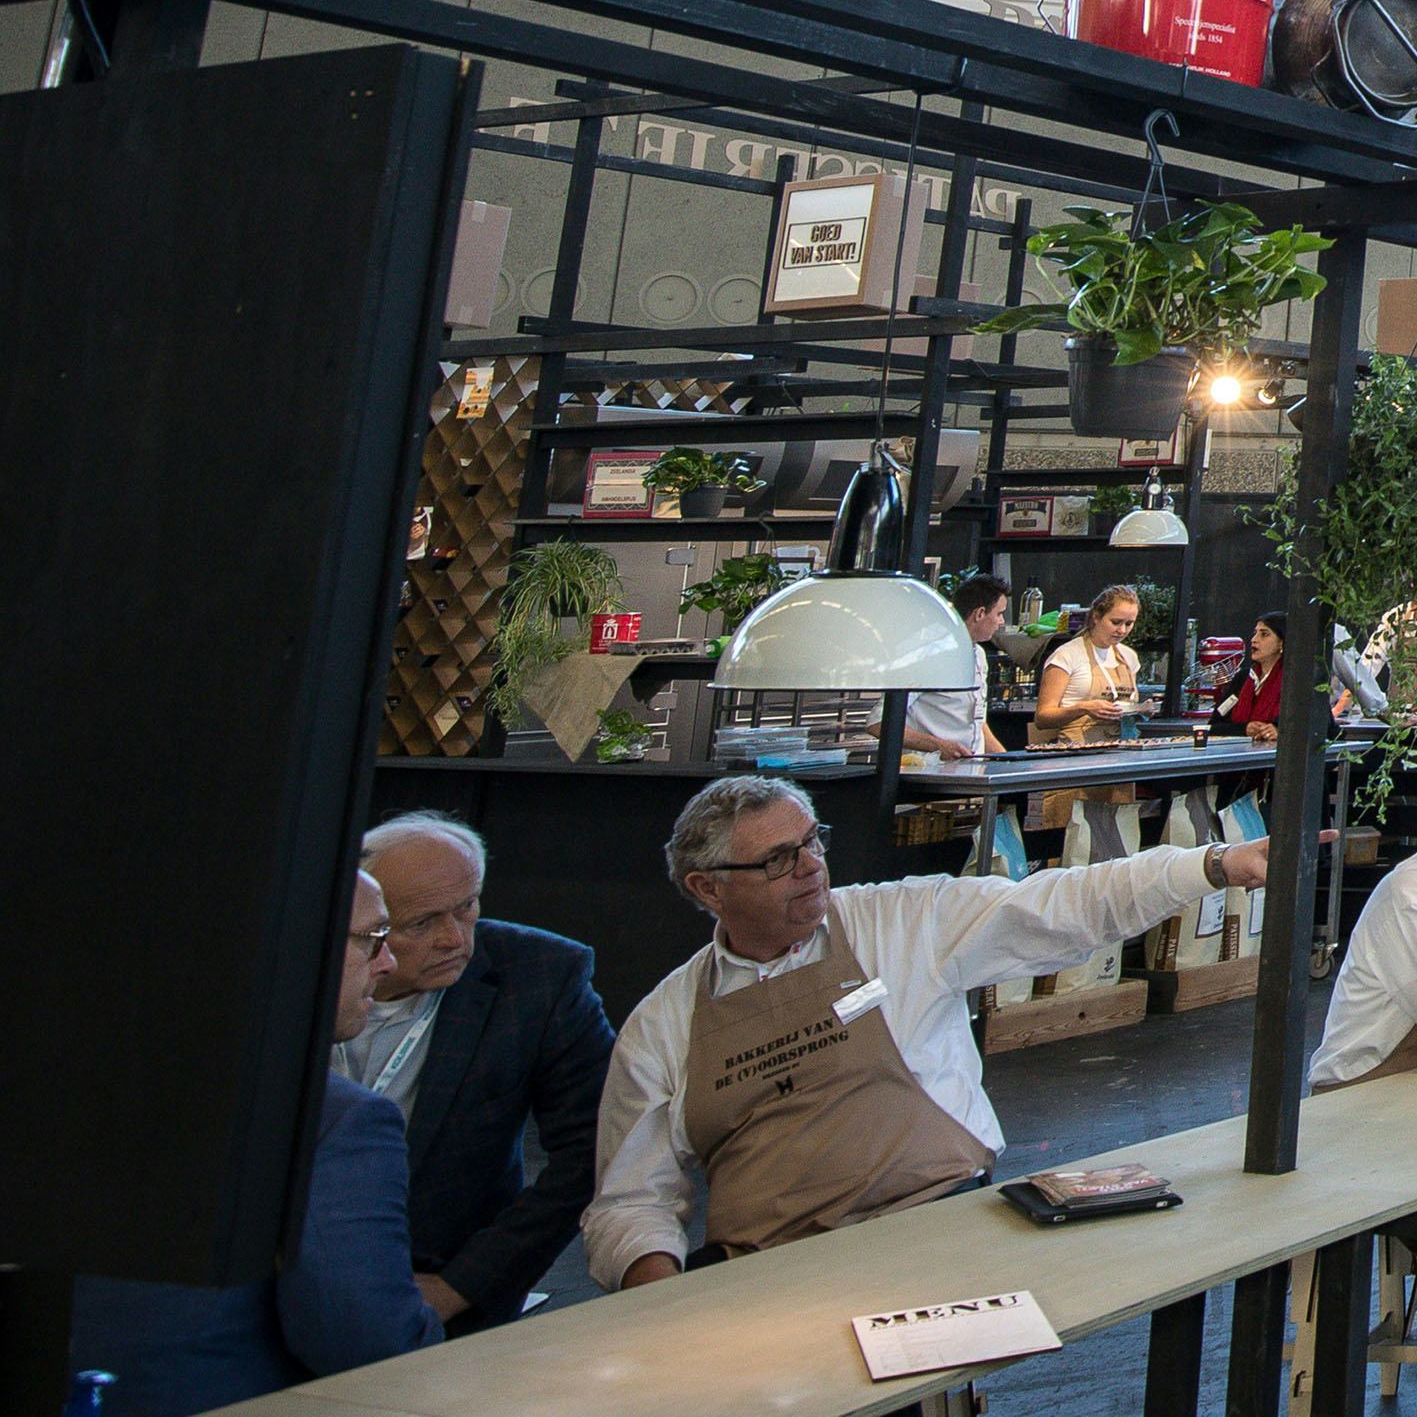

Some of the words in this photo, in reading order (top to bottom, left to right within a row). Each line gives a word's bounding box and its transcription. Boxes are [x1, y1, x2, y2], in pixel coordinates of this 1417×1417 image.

[811, 223, 843, 243] GOED
[791, 245, 814, 265] VAN
[815, 242, 857, 263] START!
[715, 1074, 733, 1092] DE
[737, 1029, 849, 1084] (V)OORSPRONG
[724, 1030, 800, 1070] BAKKERIJ
[804, 1017, 834, 1038] VAN
[871, 1295, 1018, 1329] MENU
